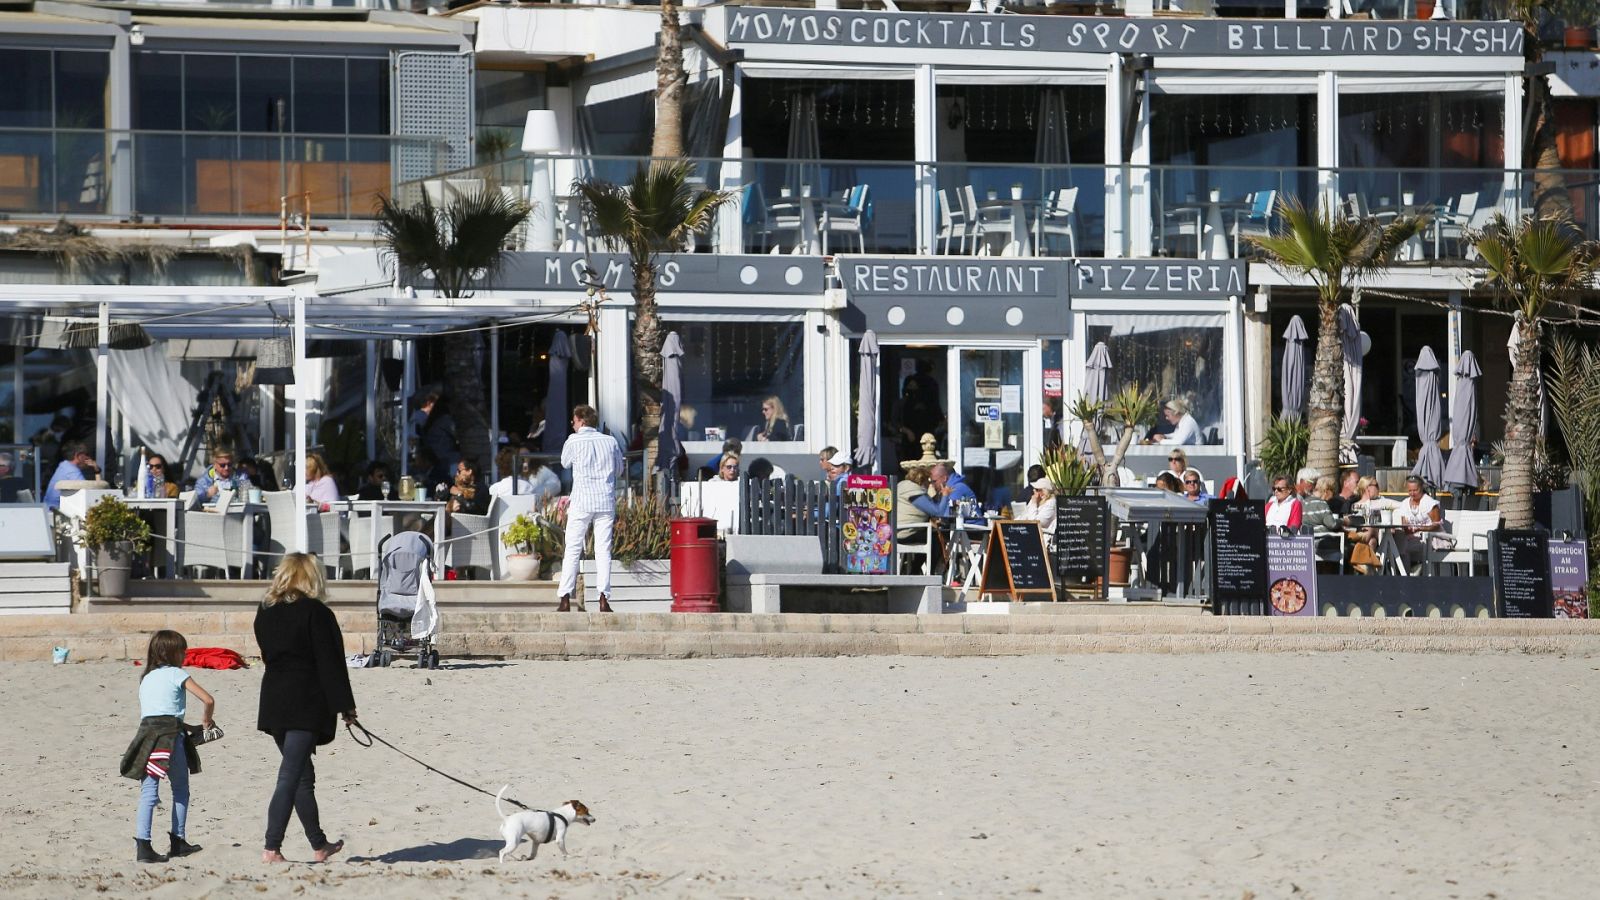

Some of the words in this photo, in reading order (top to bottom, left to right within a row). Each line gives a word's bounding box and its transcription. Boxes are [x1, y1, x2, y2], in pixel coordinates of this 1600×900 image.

[729, 12, 842, 40] MOMOS
[850, 17, 1036, 47] COCKTAILS
[1067, 22, 1196, 50] SPORT
[1228, 24, 1402, 51] BILLIARD
[1413, 26, 1525, 54] SHISHA
[544, 257, 681, 289] MOMS
[854, 264, 1045, 292] RESTAURANT
[1077, 264, 1242, 291] PIZZERIA
[1554, 566, 1579, 574] STRAND
